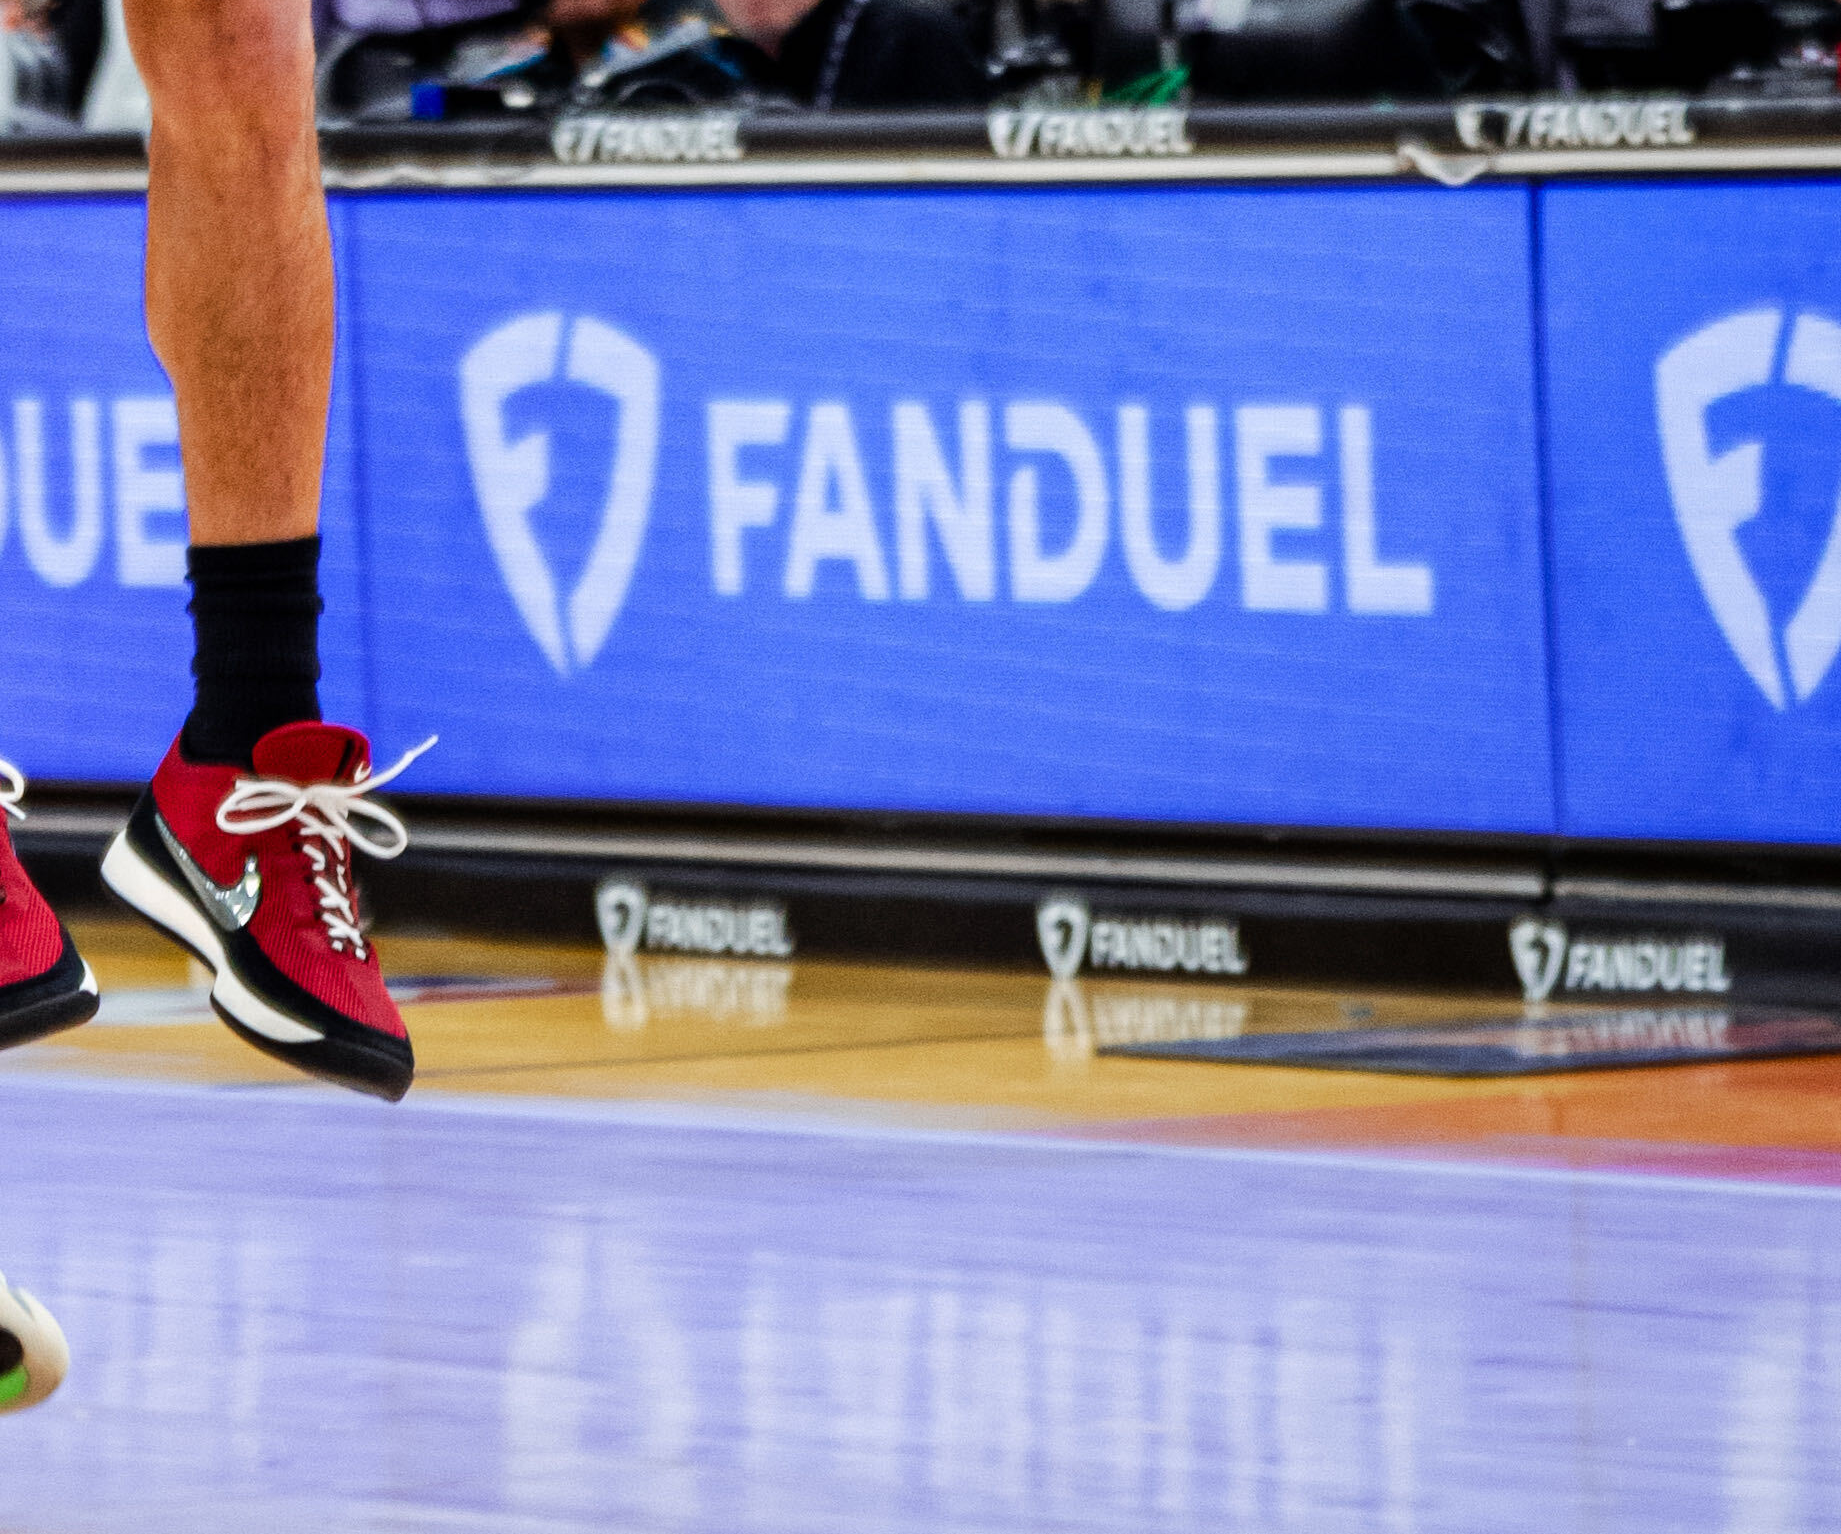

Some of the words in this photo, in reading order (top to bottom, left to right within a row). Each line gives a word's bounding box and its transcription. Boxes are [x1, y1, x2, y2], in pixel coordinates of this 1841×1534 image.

[601, 117, 745, 162] FANDUEL
[1038, 110, 1194, 155] FANDUEL
[1527, 100, 1696, 147] FANDUEL
[705, 397, 1435, 617] FANDUEL
[646, 904, 794, 956] FANDUEL
[1090, 920, 1249, 974] FANDUEL
[1565, 941, 1732, 993] FANDUEL
